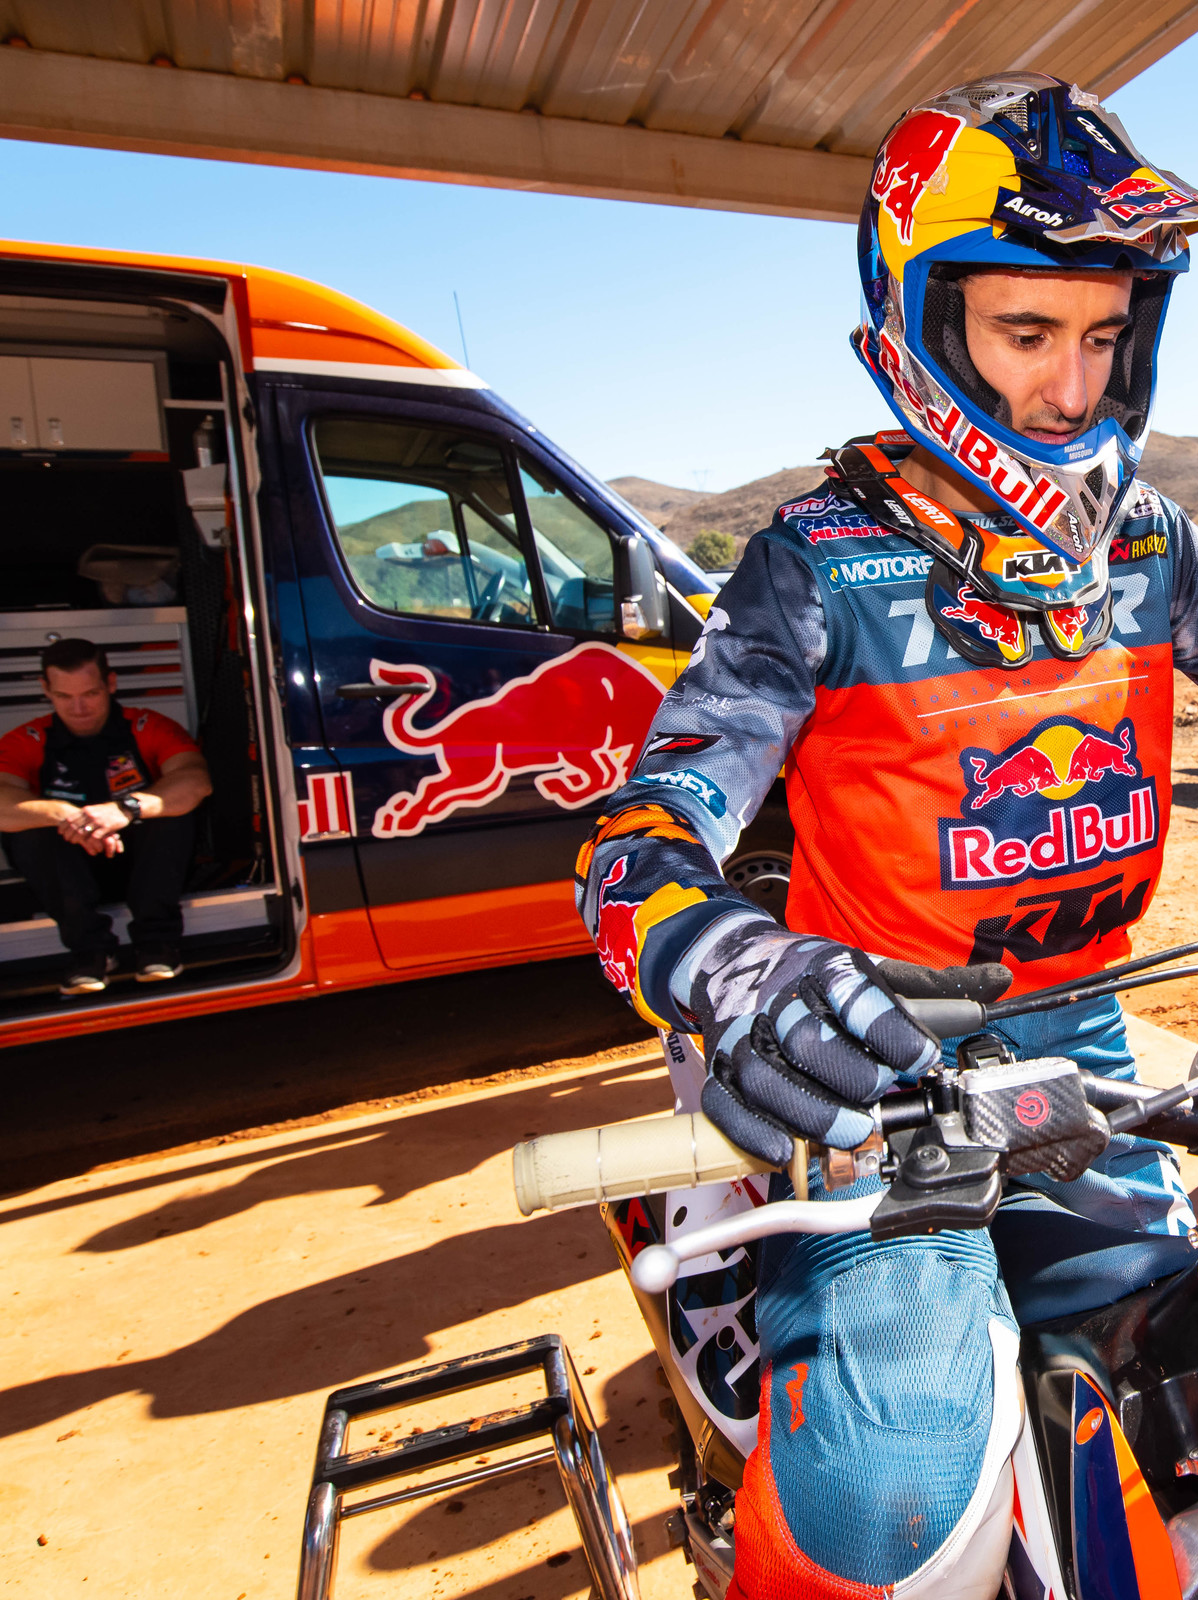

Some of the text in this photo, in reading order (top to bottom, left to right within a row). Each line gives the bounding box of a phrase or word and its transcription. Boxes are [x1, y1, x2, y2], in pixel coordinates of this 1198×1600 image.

[1003, 196, 1064, 227] Airoh
[1109, 190, 1193, 221] Red
[879, 328, 1070, 532] Red Bull
[1064, 442, 1086, 454] MARVIN
[1068, 448, 1094, 460] MUSQUIN
[1067, 510, 1084, 554] Airoh
[839, 553, 936, 583] MOTORE
[950, 789, 1154, 882] Red Bull
[967, 873, 1151, 968] KTM
